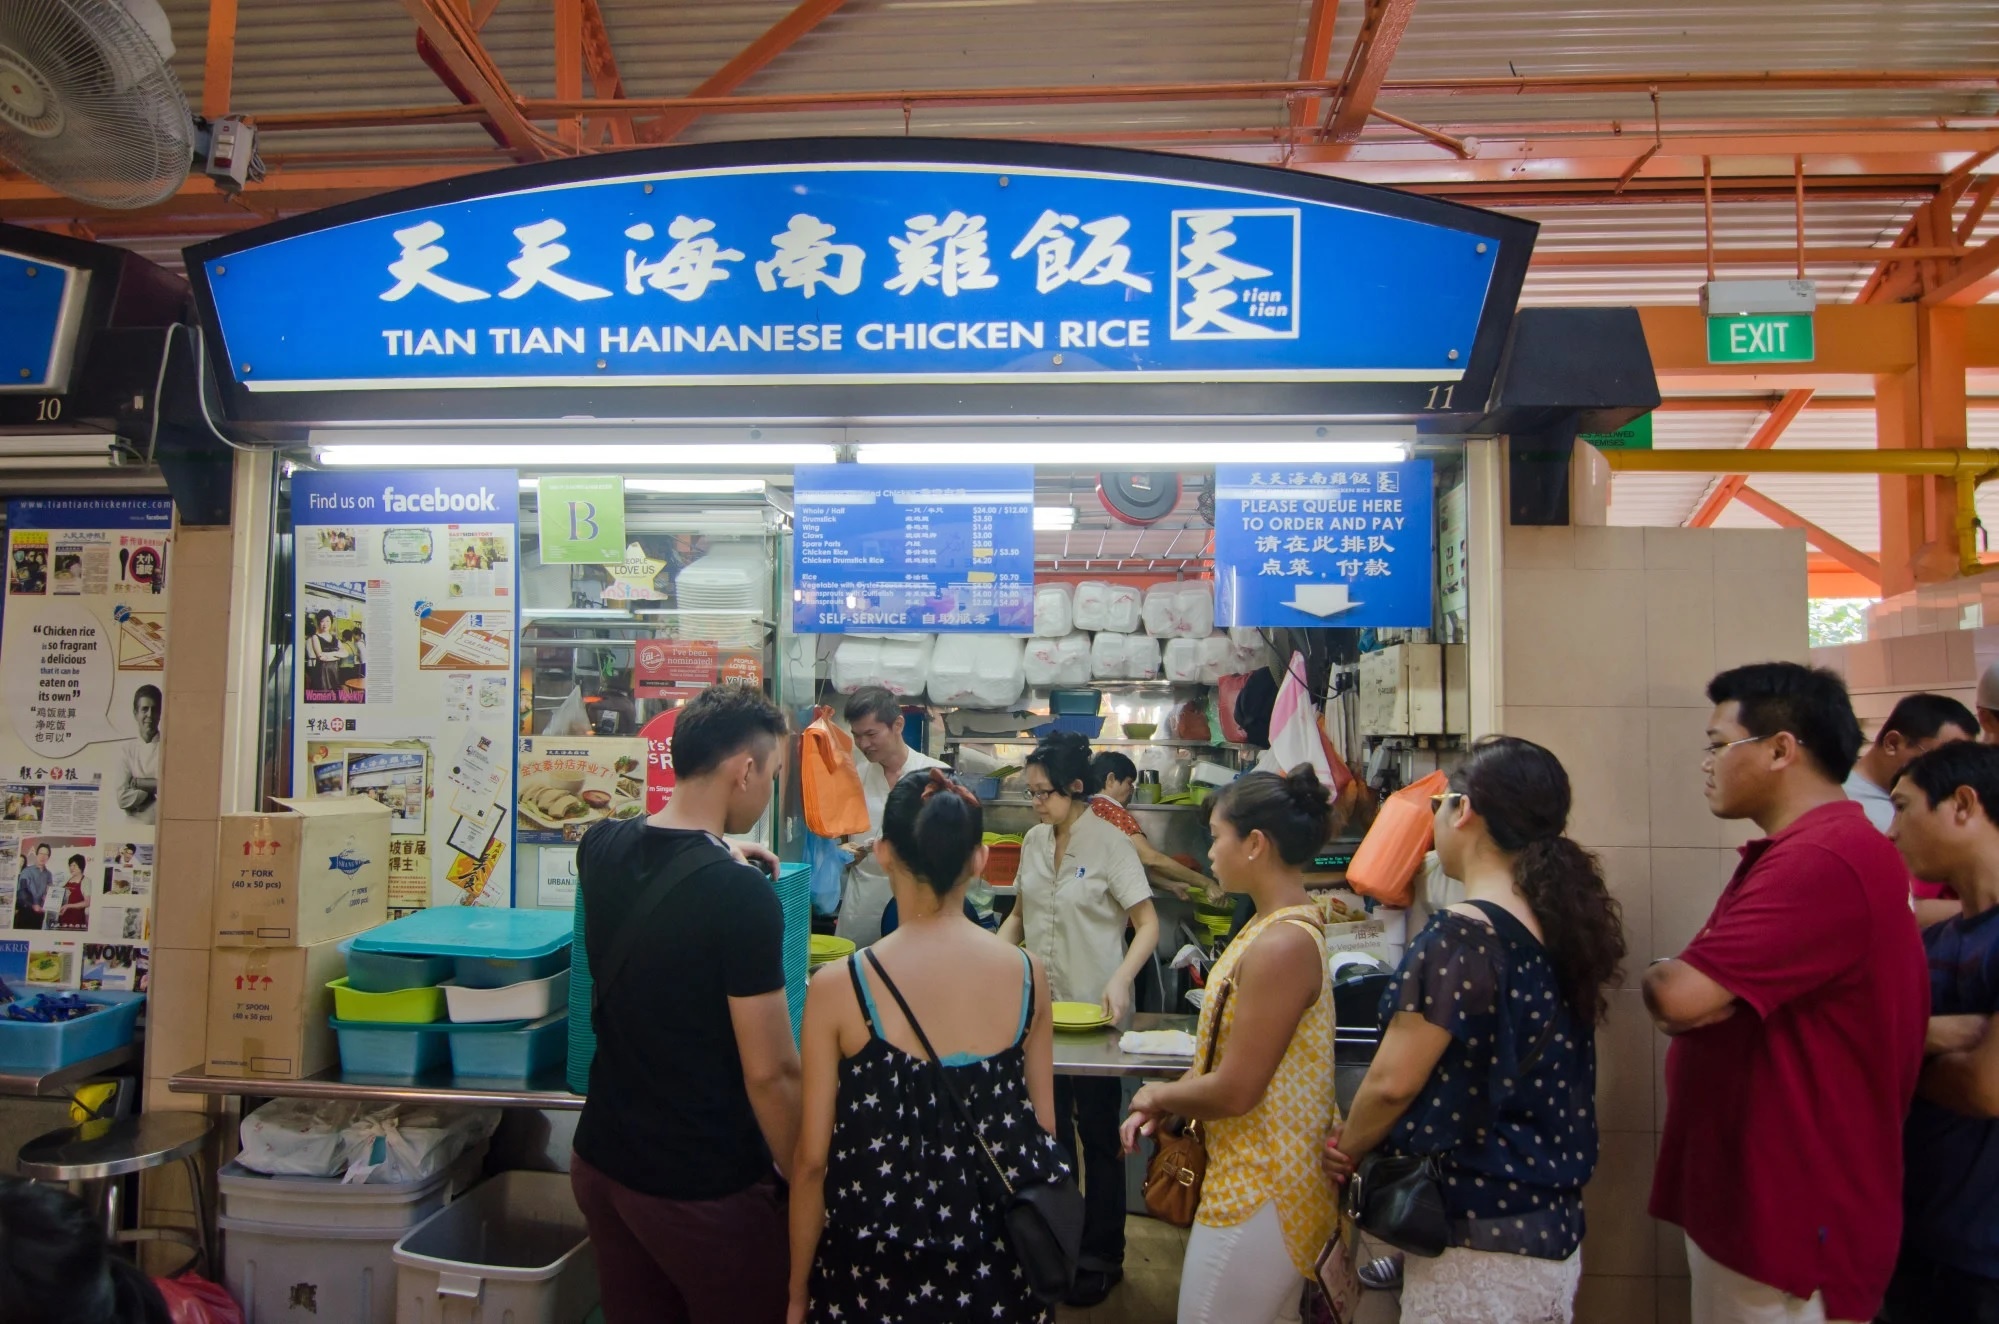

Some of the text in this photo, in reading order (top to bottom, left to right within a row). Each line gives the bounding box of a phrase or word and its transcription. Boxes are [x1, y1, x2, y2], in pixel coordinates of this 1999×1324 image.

[378, 208, 1152, 303] 天天海南雞飯
[1243, 287, 1282, 303] tian
[1249, 303, 1288, 317] tian
[381, 319, 1151, 356] TIAN TIAN HAINANESE CHICKEN RICE
[1729, 322, 1789, 354] EXIT
[1423, 385, 1455, 410] 11
[36, 397, 62, 421] 10
[20, 500, 171, 509] www.tiantianchickenrice.com
[309, 486, 496, 513] Find us on facebook
[802, 507, 825, 515] Whole
[831, 507, 846, 515] Half
[1241, 499, 1403, 514] PLEASE QUEUE HERE
[568, 501, 600, 541] B
[1242, 517, 1405, 531] TO ORDER AND PAY
[802, 524, 820, 532] Wing
[802, 532, 824, 540] Claws
[802, 541, 823, 549] Spare
[1254, 535, 1395, 554] 请在此排队
[625, 557, 648, 565] EOPLE
[614, 565, 655, 575] LOVE US
[802, 582, 839, 590] Vegetable
[414, 601, 434, 617] Branch
[818, 612, 907, 625] SELF-SERVICE
[922, 612, 990, 625] 自助服务
[79, 626, 96, 637] rice
[48, 642, 58, 651] so
[60, 640, 97, 653] fragrant
[672, 648, 708, 657] I've been
[47, 654, 87, 665] delicious
[667, 657, 713, 665] nominated!
[72, 667, 80, 675] be
[39, 679, 66, 688] eaten
[38, 691, 50, 701] its
[305, 689, 337, 701] Women's
[251, 869, 274, 878] FORK
[231, 880, 245, 889] (40
[253, 880, 264, 888] 50
[265, 880, 282, 890] pcs)
[245, 1003, 270, 1011] SPOON
[232, 1012, 244, 1020] (40
[259, 1014, 273, 1022] pcs)
